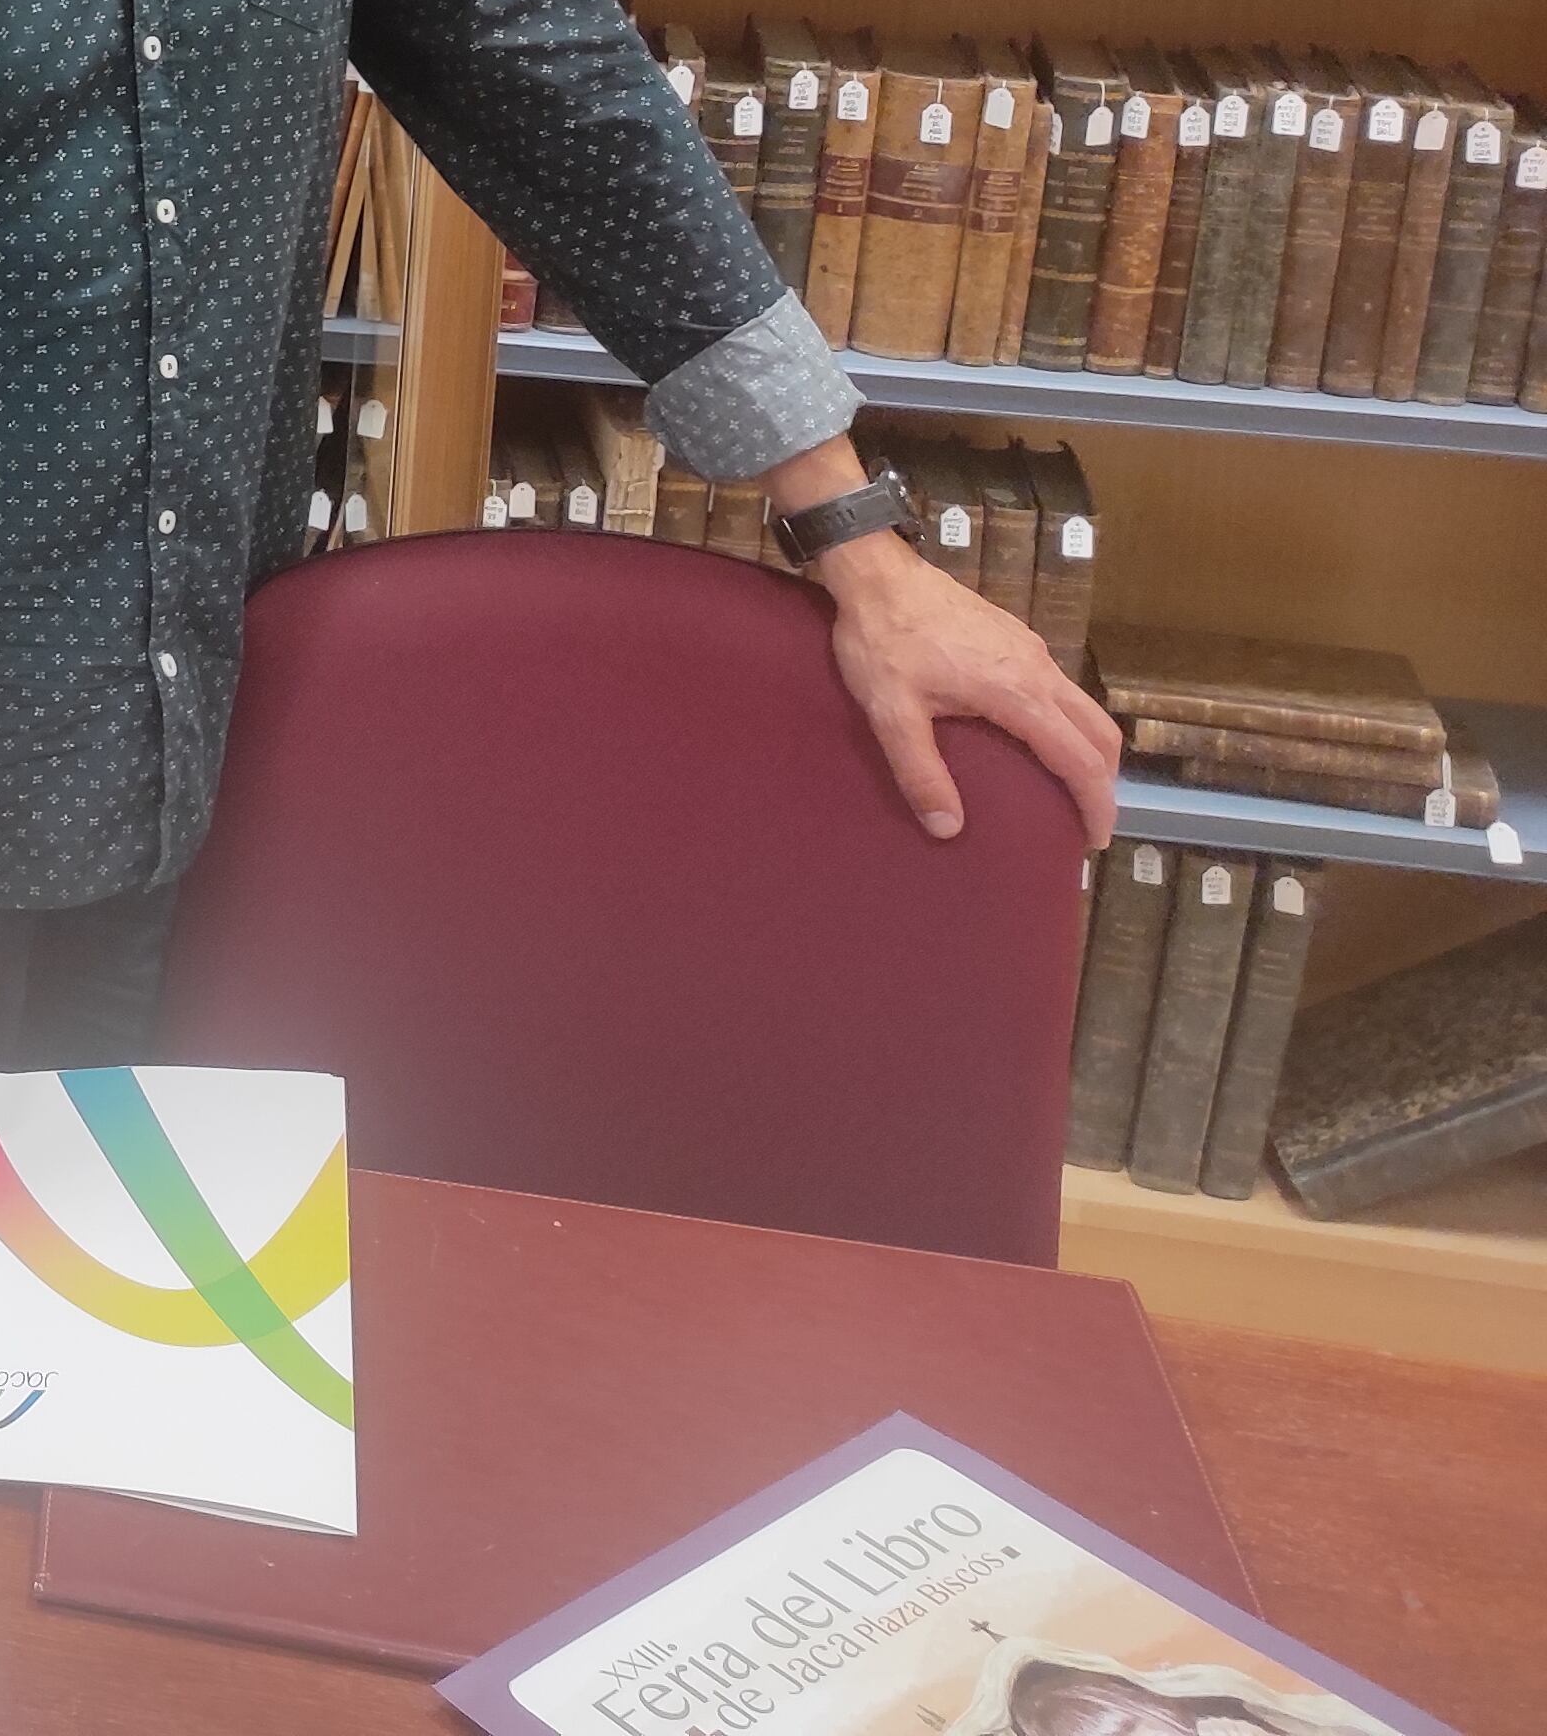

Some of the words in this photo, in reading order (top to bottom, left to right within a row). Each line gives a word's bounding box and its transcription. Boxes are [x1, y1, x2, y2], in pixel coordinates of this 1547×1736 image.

[591, 1640, 760, 1736] Feria
[745, 1569, 852, 1650] del
[824, 1503, 983, 1597] Libro
[599, 1639, 678, 1689] XXIII.
[712, 1687, 775, 1730] de
[768, 1631, 866, 1696] Jaca
[853, 1597, 929, 1645] Plaza
[916, 1551, 1006, 1607] Biscós
